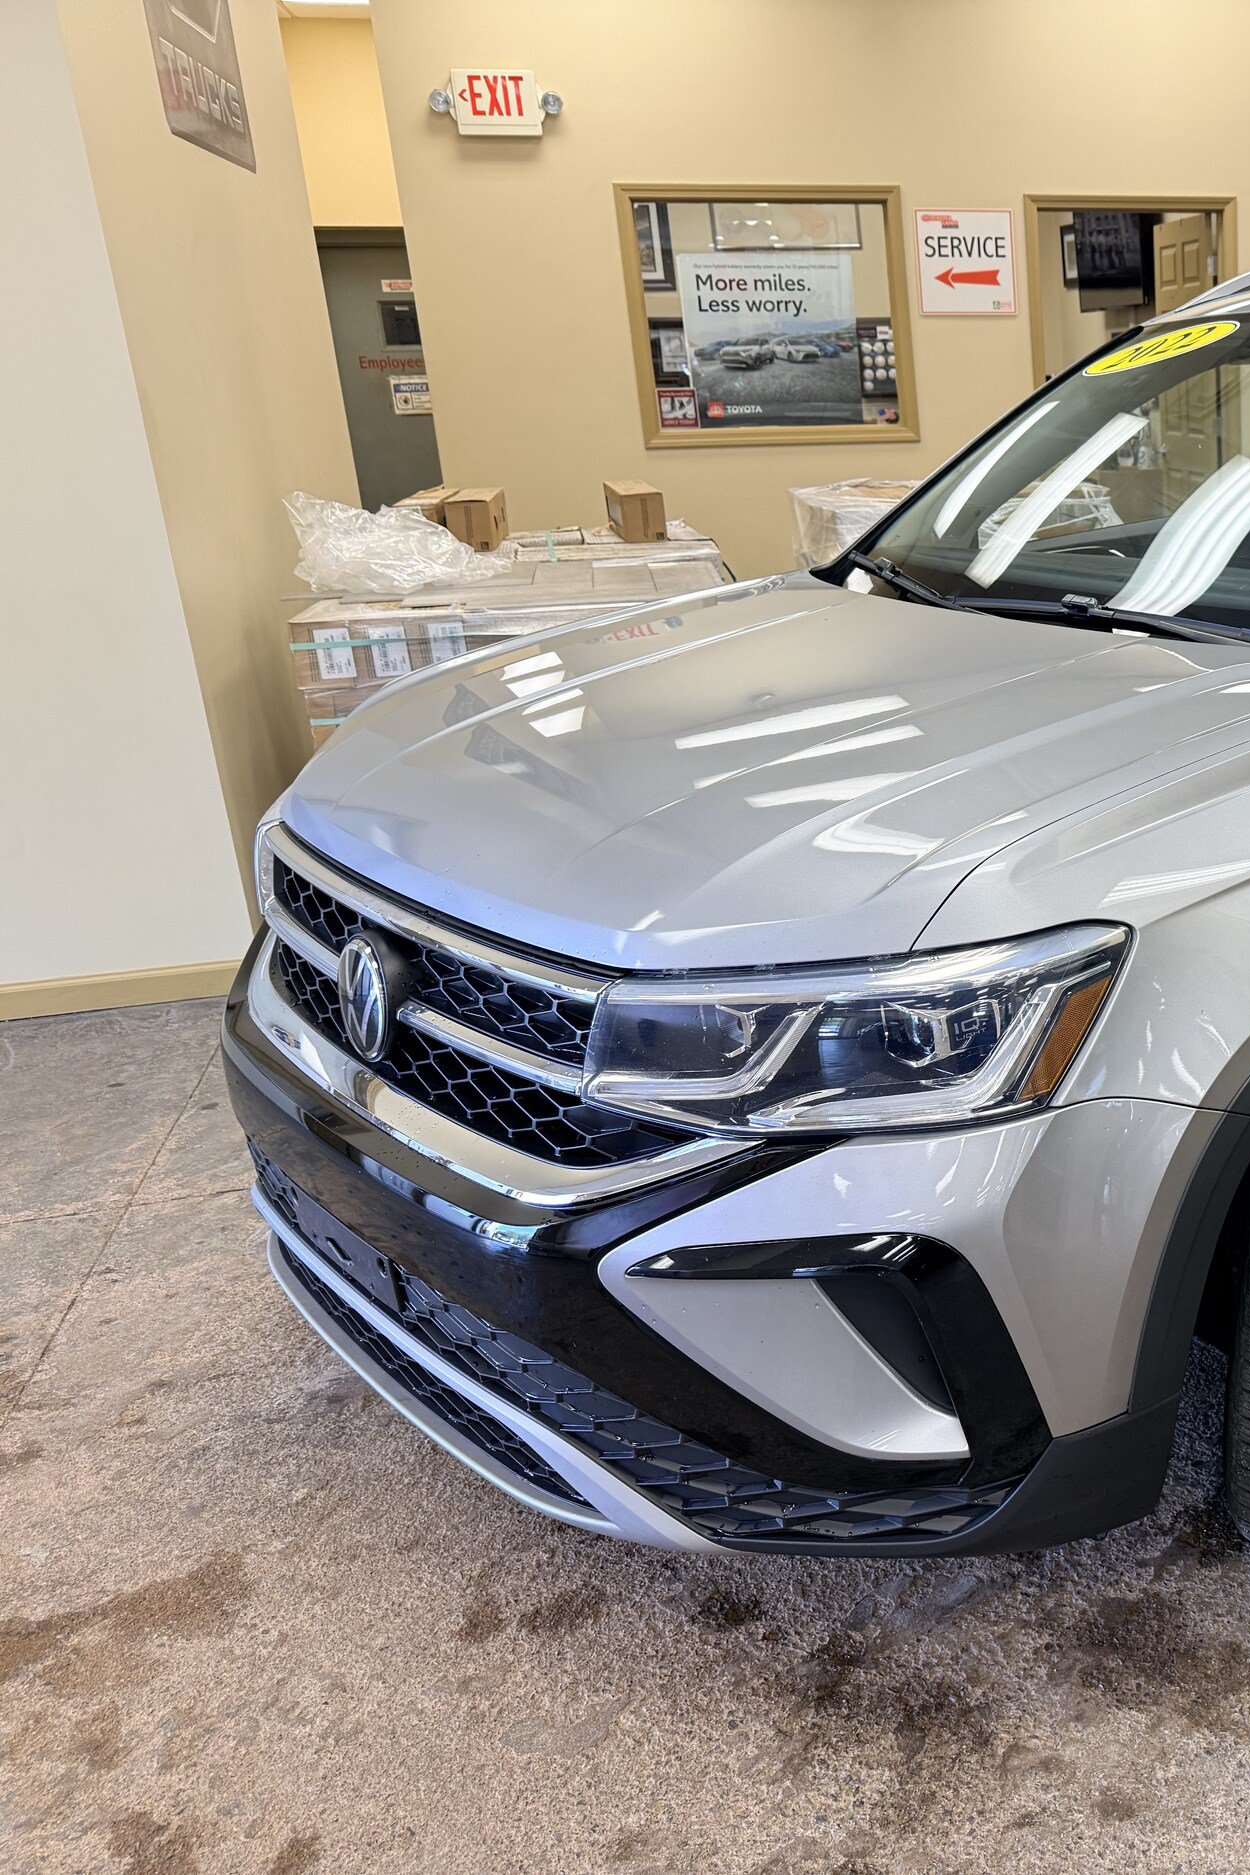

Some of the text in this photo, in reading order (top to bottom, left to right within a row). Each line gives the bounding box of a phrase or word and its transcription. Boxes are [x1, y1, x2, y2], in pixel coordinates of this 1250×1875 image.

[158, 36, 245, 134] TRUCKS
[467, 75, 524, 116] EXIT
[924, 235, 1006, 258] SERVICE
[695, 273, 811, 292] More miles.
[697, 295, 808, 317] Less worry.
[1101, 325, 1217, 371] 2022
[358, 355, 425, 372] Employee
[400, 384, 428, 392] NOTICE
[726, 405, 763, 413] TOYOTA
[955, 1026, 987, 1042] LIGHT
